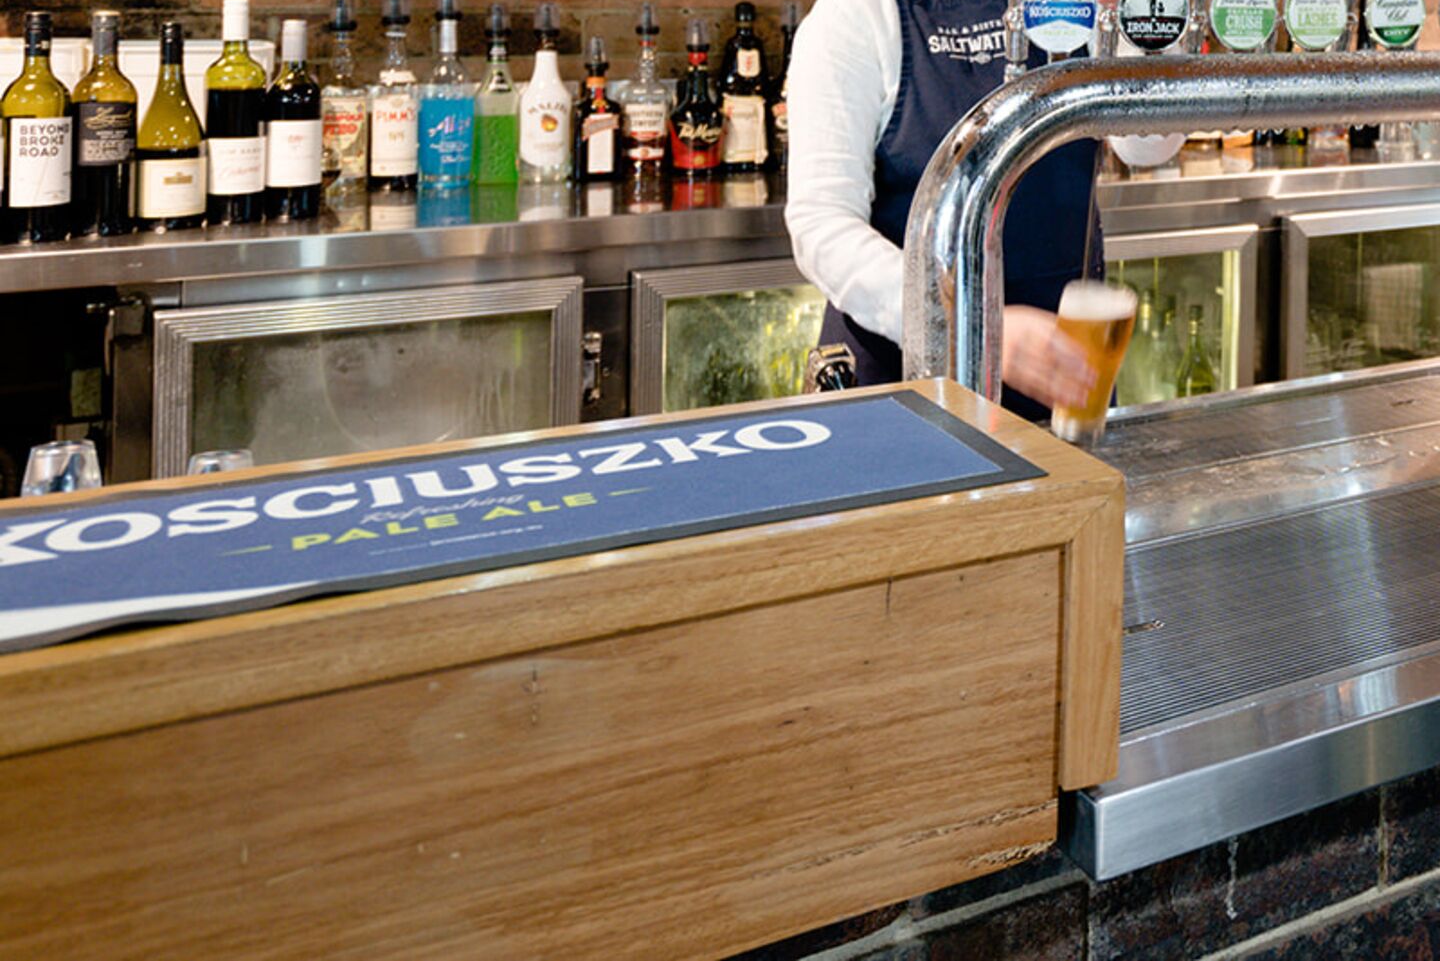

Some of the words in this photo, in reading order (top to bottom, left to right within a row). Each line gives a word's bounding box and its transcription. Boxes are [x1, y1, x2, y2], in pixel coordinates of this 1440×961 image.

[18, 146, 59, 158] ROAD
[291, 513, 460, 551] PALE
[481, 492, 598, 522] ALE
